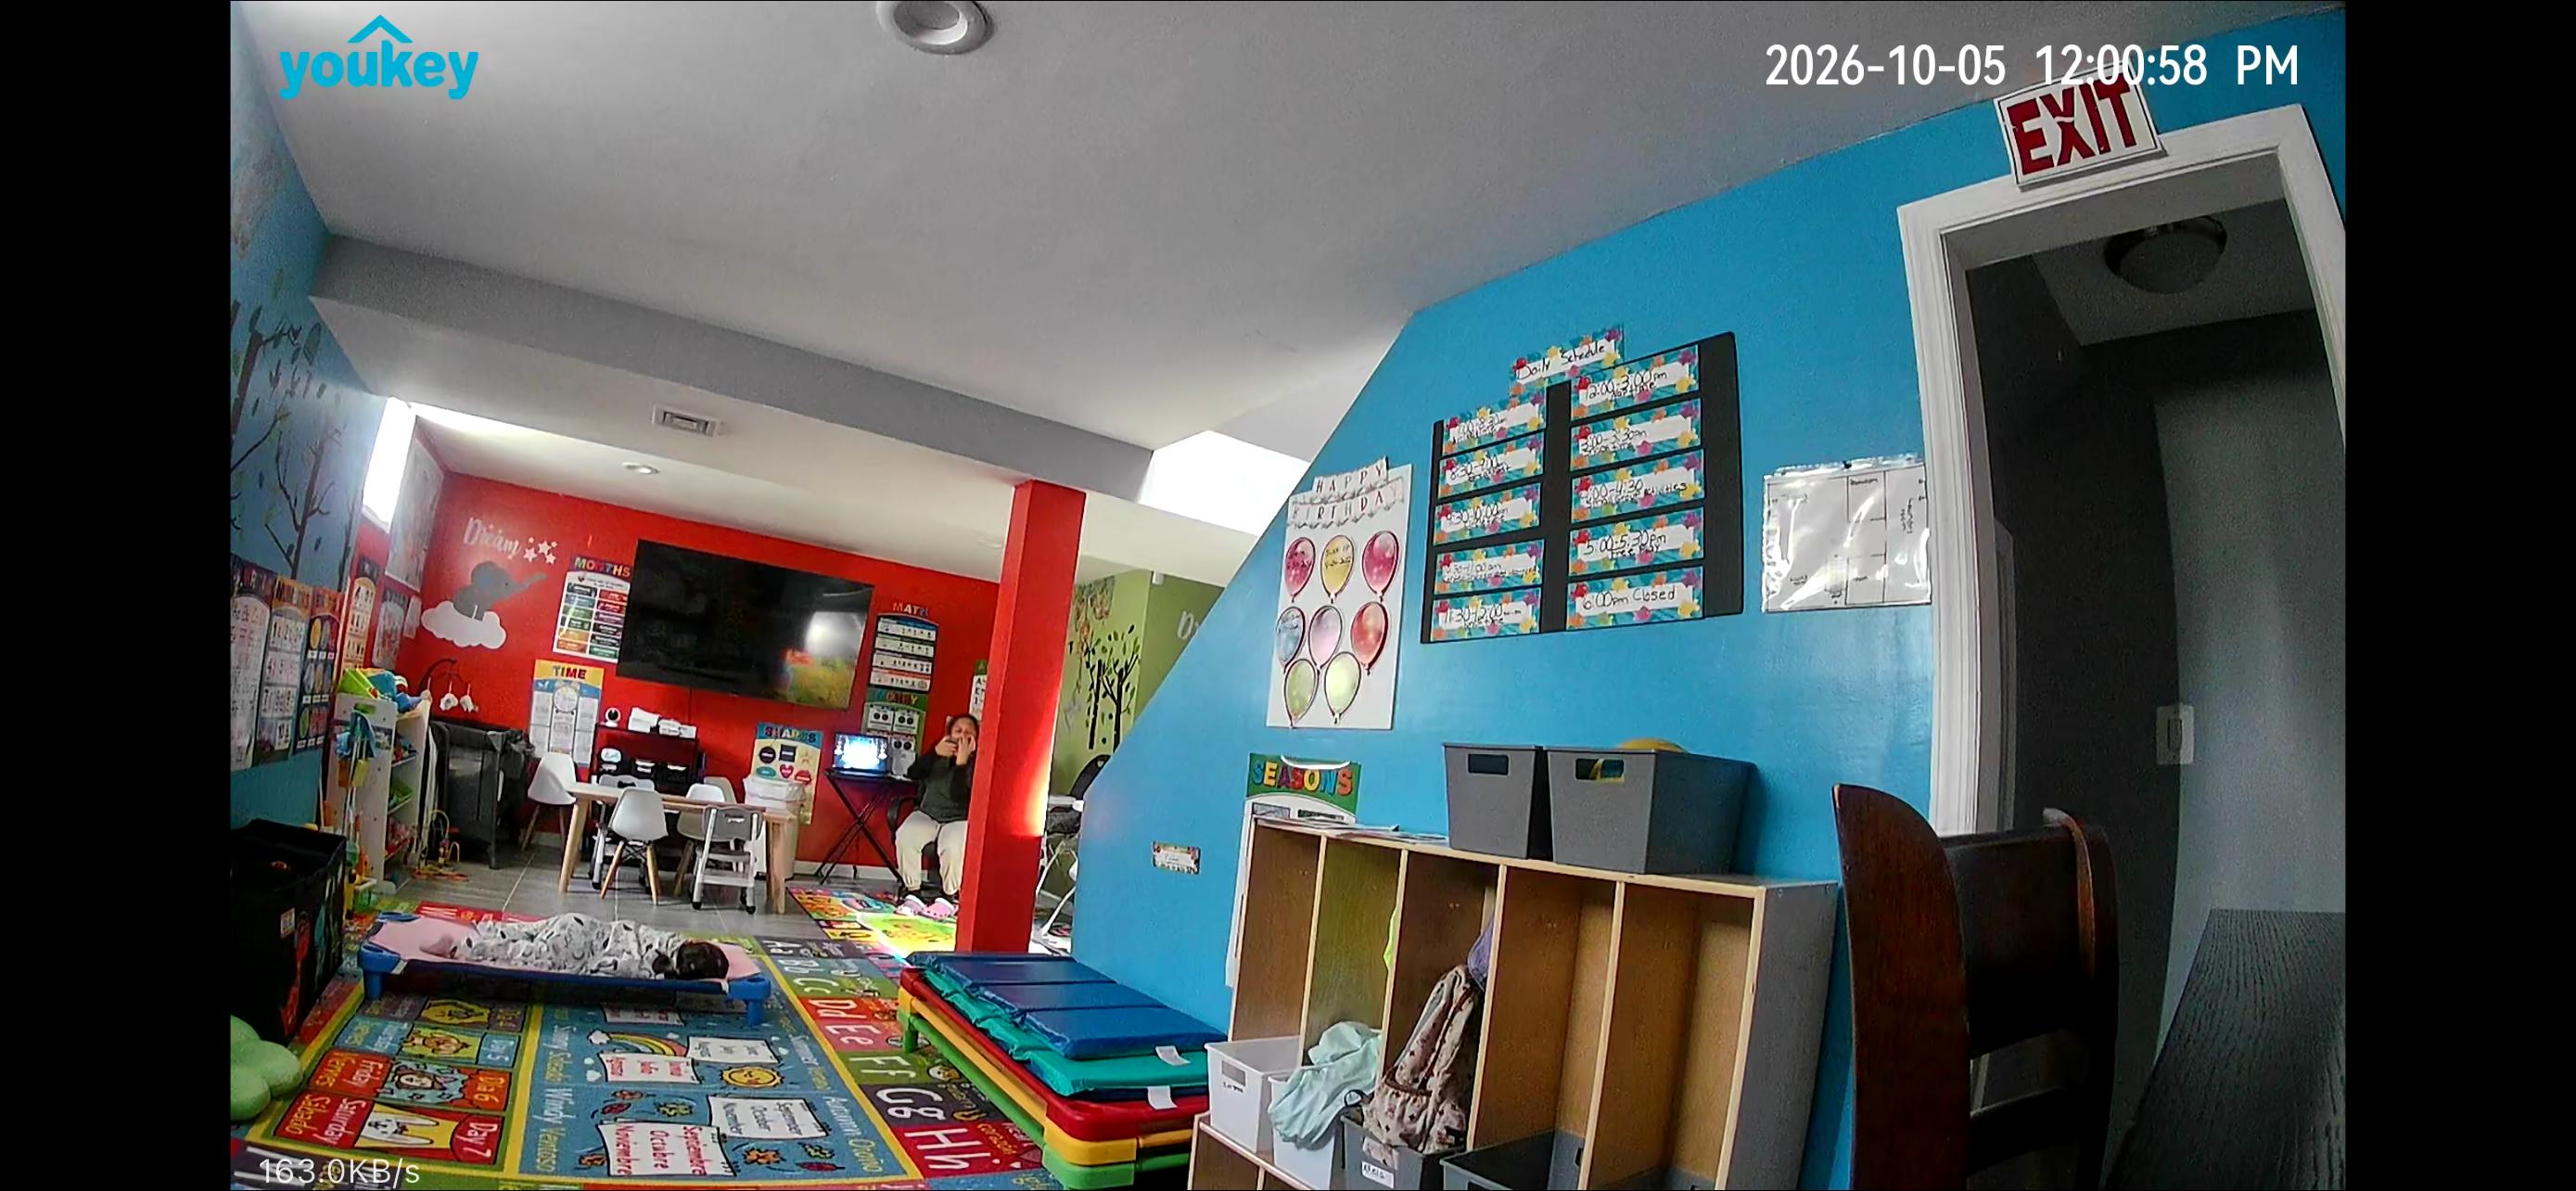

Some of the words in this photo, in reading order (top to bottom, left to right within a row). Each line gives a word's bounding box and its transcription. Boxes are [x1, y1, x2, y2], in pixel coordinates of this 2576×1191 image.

[2006, 72, 2138, 175] EXIT
[1316, 465, 1384, 493] HAPPY
[1293, 488, 1396, 520] BIRTHDA
[465, 518, 521, 556] Dream
[553, 665, 587, 680] TIME
[1252, 761, 1353, 796] SEASONS
[808, 999, 867, 1019] Dd
[823, 1024, 881, 1046] Ee
[344, 1059, 383, 1088] Friday
[312, 1097, 367, 1146] Saturday
[454, 1122, 499, 1146] Day
[464, 1147, 491, 1159] 7
[614, 1124, 635, 1176] Noviembre
[649, 1130, 671, 1169] Octubre
[680, 1125, 708, 1177] Septiembre
